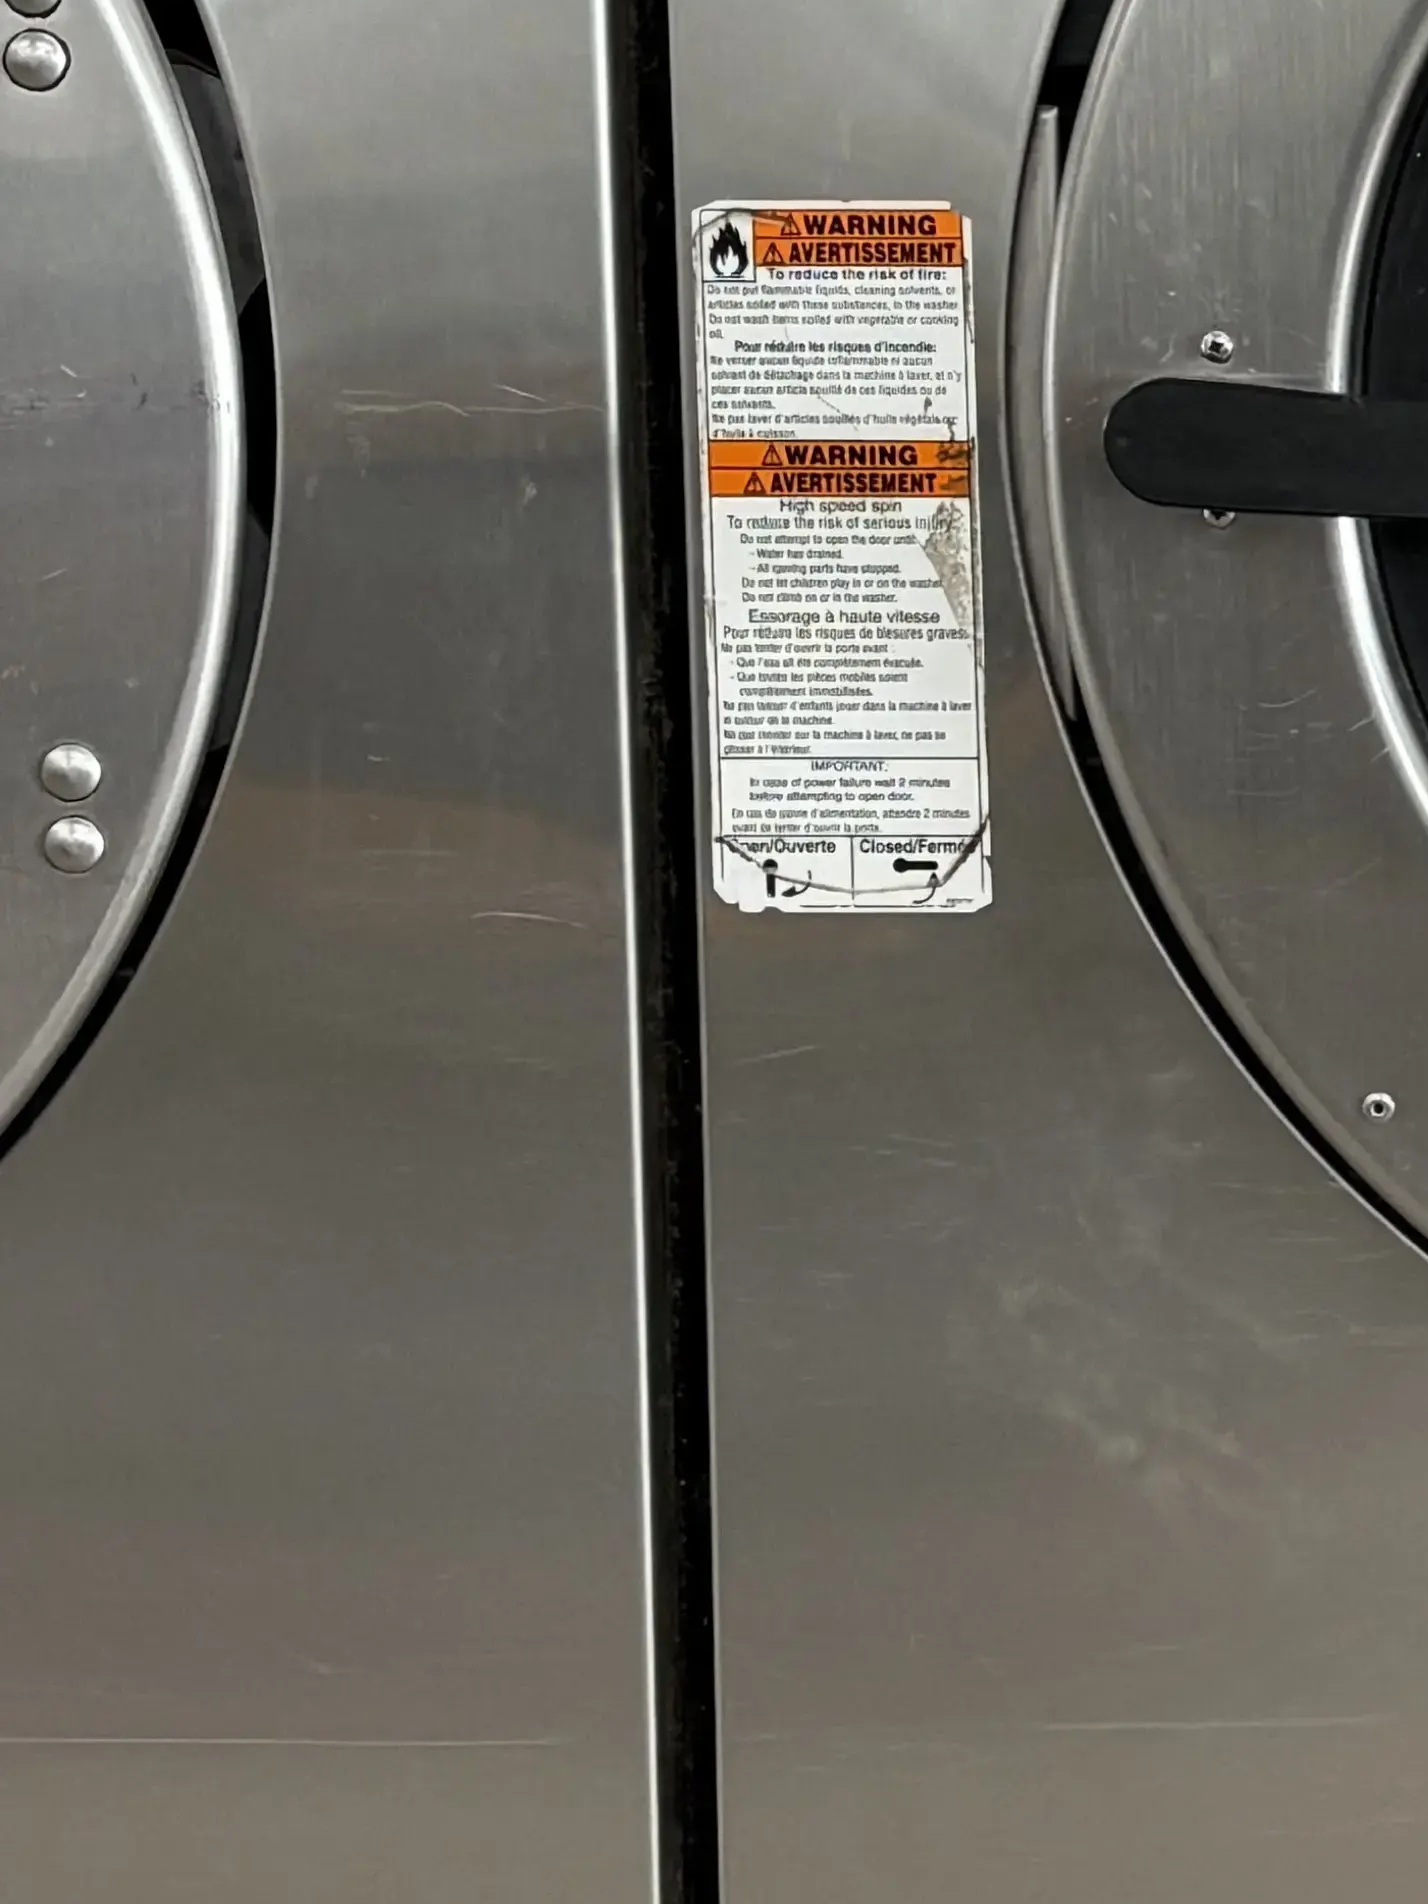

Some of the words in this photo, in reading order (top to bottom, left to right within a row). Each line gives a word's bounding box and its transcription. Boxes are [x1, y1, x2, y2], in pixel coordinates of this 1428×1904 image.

[803, 215, 936, 235] WARNING
[789, 242, 955, 263] AVERTISSEMENT
[768, 268, 784, 280] To
[788, 268, 838, 280] reduce
[843, 268, 865, 280] the
[869, 268, 895, 280] risk
[900, 268, 914, 280] of
[919, 268, 946, 280] fire:
[785, 445, 918, 465] WARNING
[771, 473, 937, 493] AVERTISSEMENT
[780, 500, 814, 515] High
[819, 500, 866, 514] speed
[872, 499, 902, 514] spin
[727, 515, 742, 529] To
[794, 516, 814, 529] the
[819, 516, 842, 529] risk
[847, 516, 859, 529] of
[863, 516, 911, 529] serious
[749, 609, 820, 625] Essorage
[840, 609, 881, 623] haute
[887, 609, 940, 623] vitesse
[816, 626, 855, 641] risques
[859, 626, 872, 639] de
